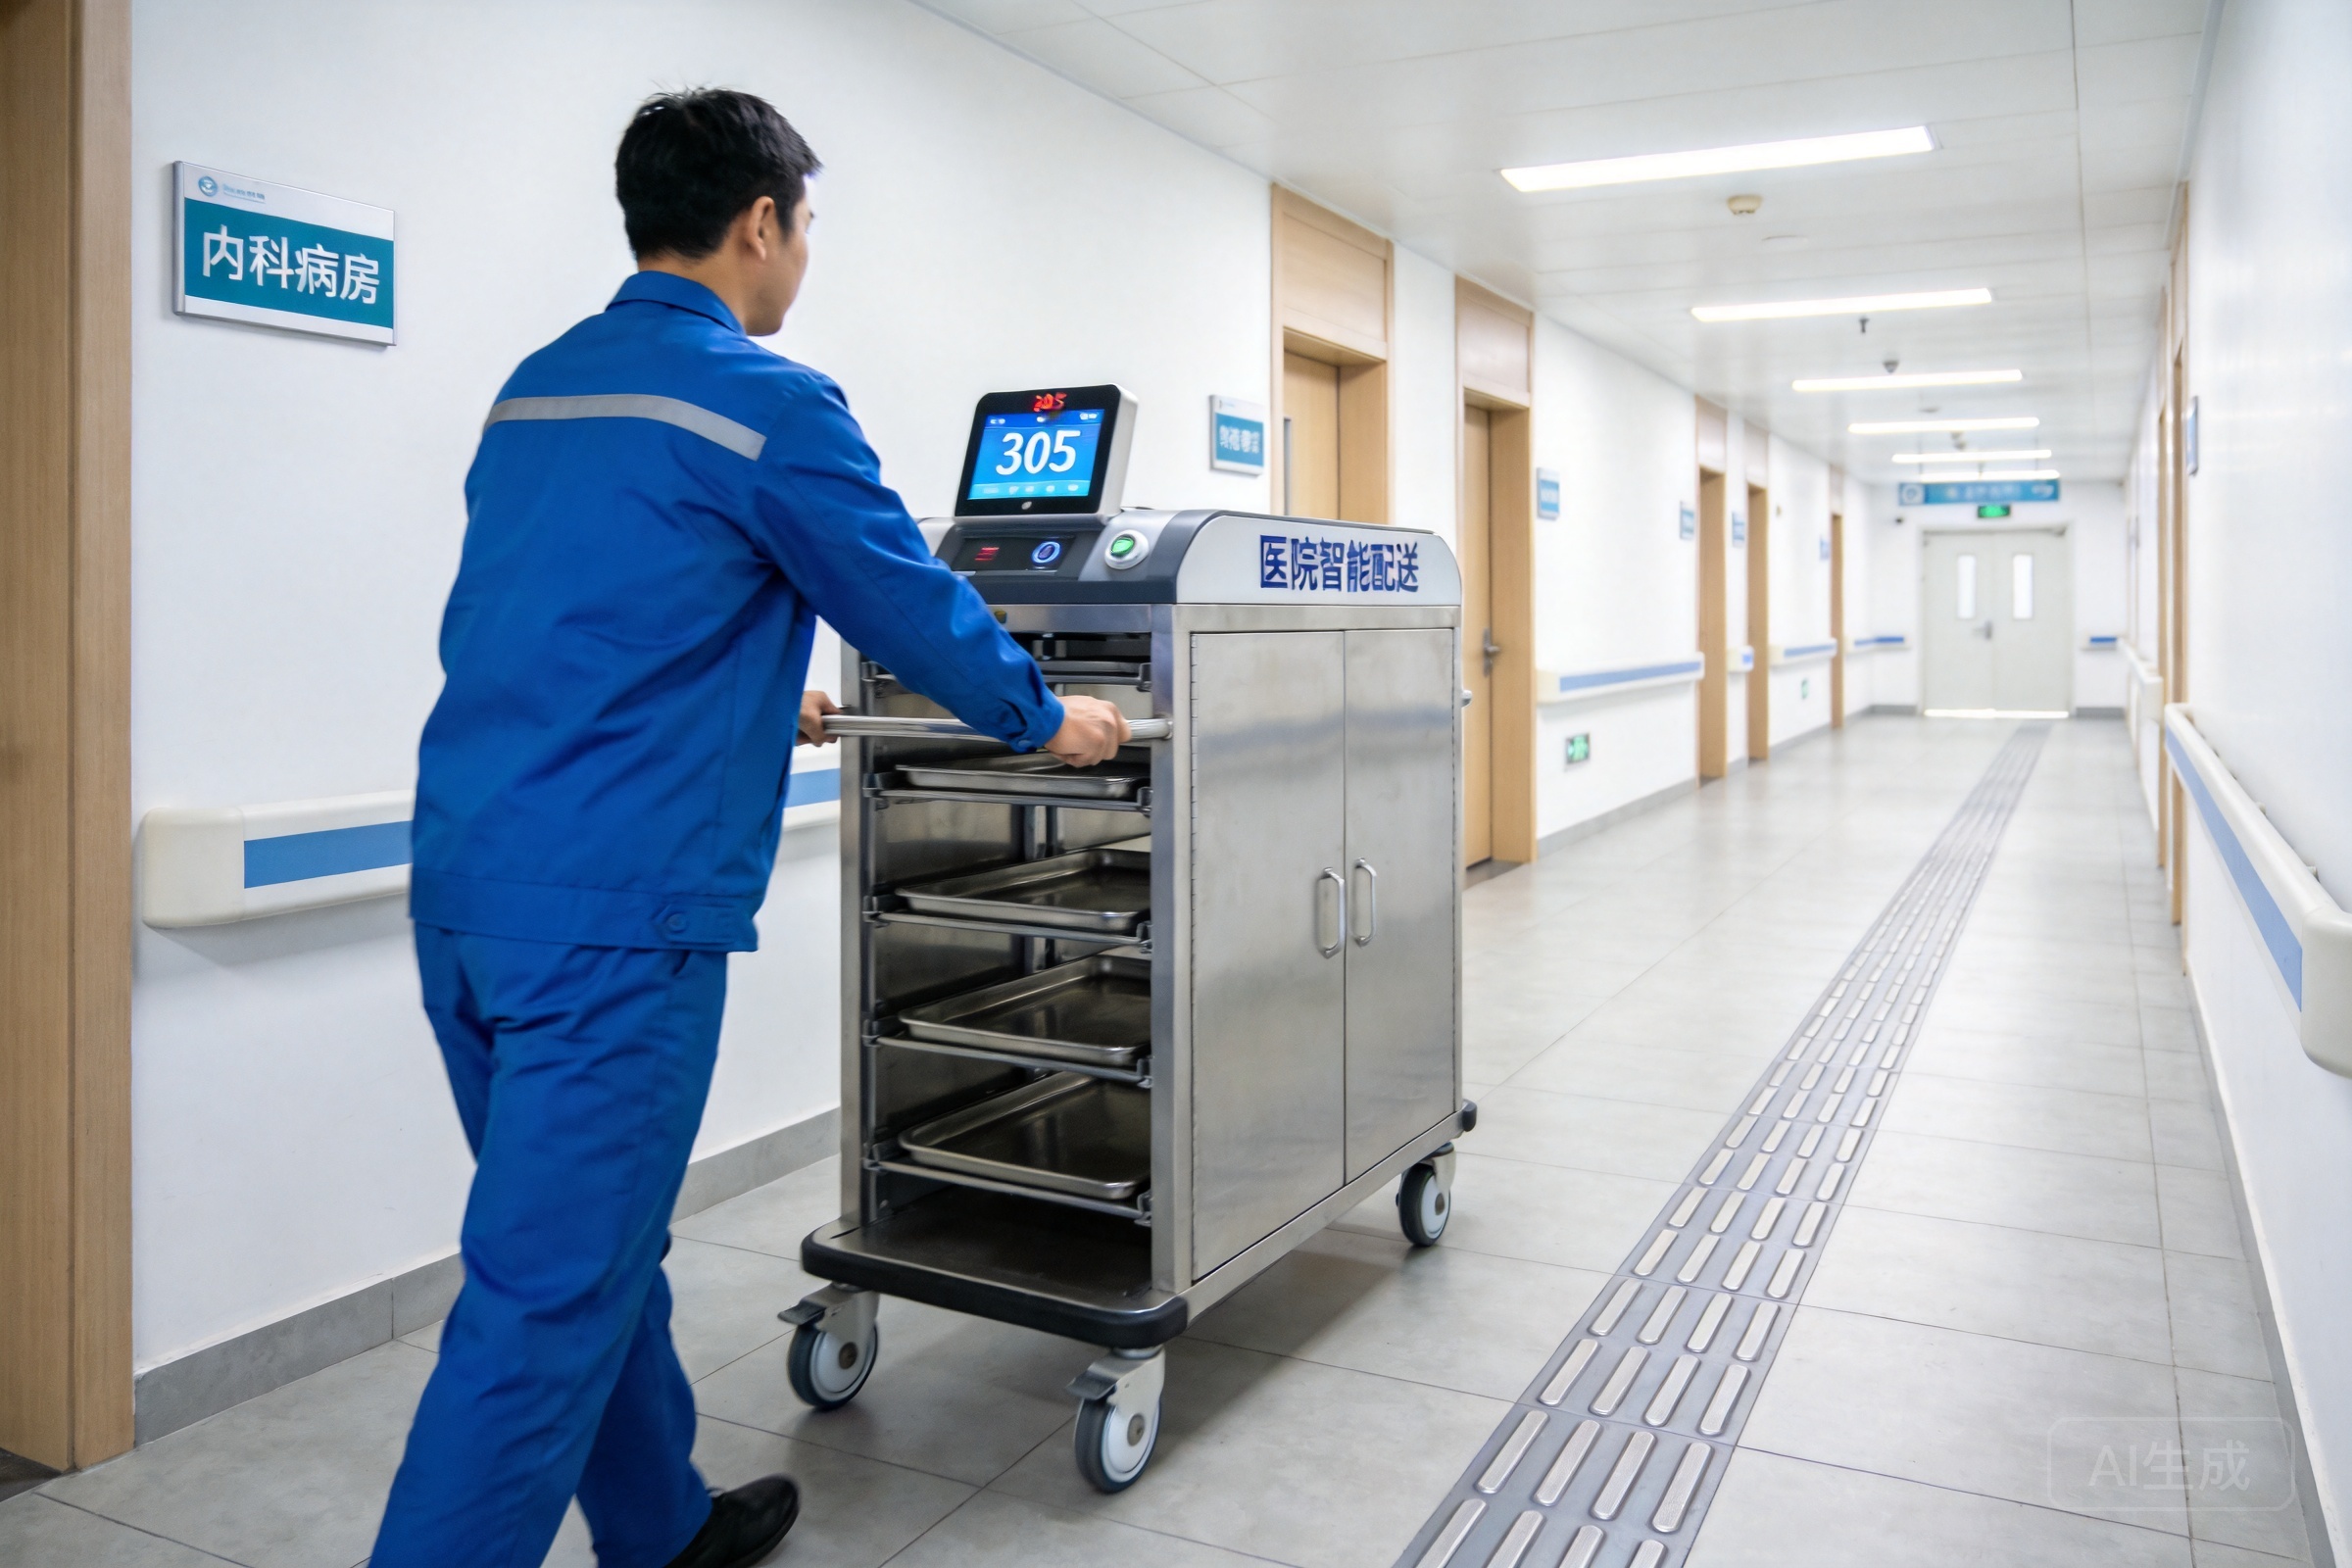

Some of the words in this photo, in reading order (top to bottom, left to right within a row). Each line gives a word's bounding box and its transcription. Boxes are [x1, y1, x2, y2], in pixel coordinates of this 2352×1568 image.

[203, 224, 379, 304] 内科病房
[996, 430, 1081, 475] 305
[1260, 534, 1419, 593] 医院智能配送
